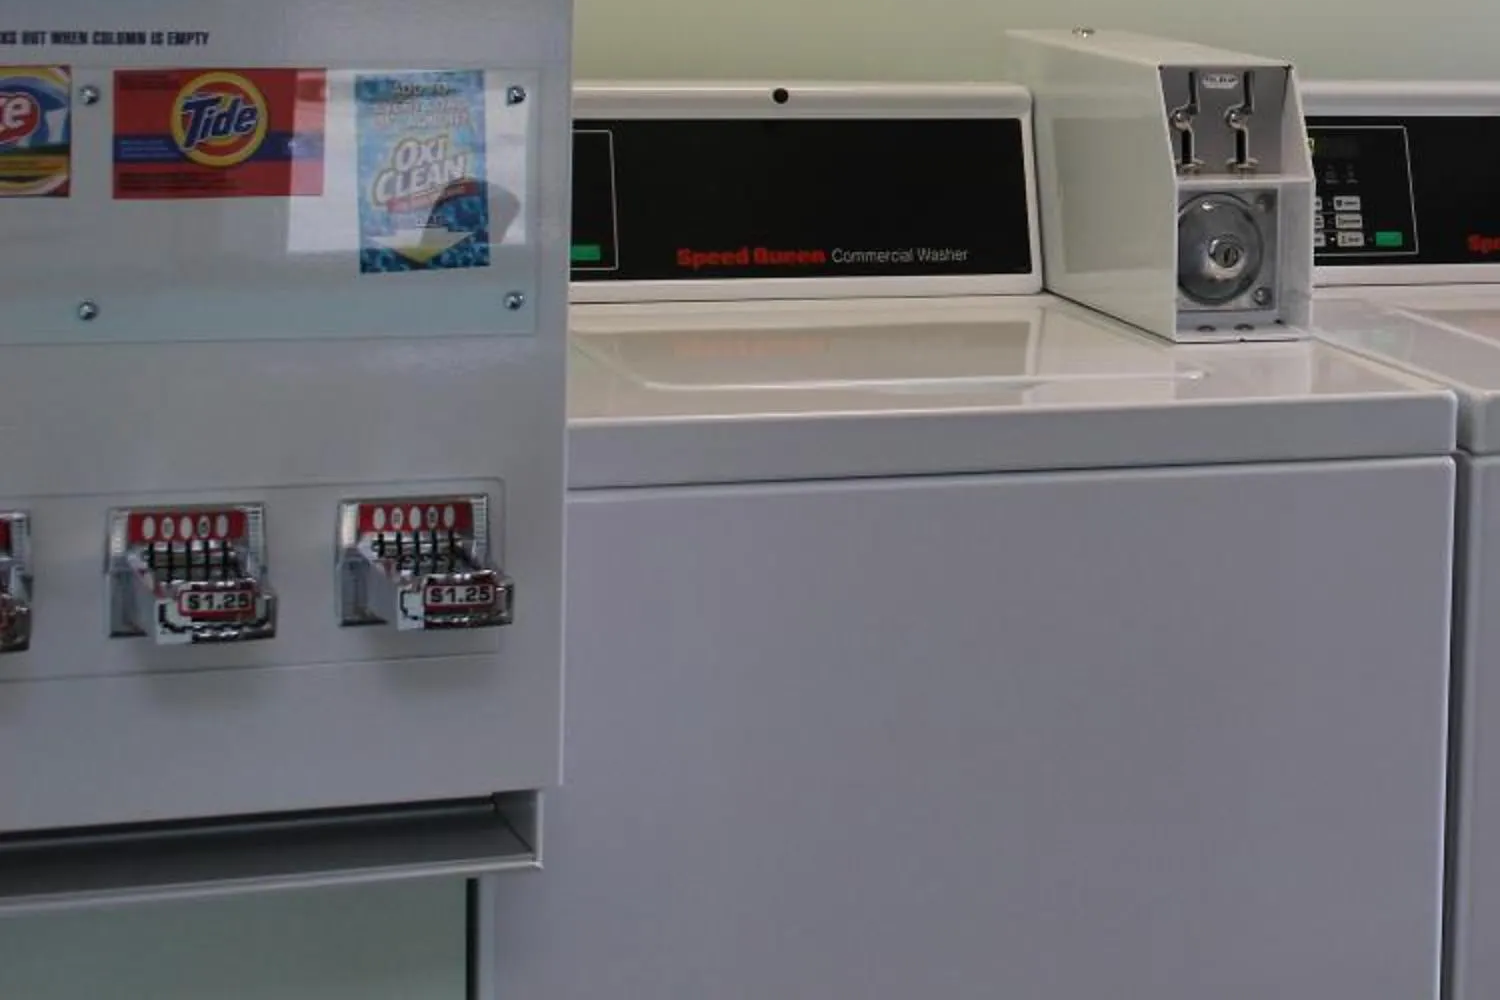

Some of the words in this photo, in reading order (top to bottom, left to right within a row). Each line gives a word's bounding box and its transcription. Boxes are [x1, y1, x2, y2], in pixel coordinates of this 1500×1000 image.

[22, 31, 47, 45] OUT
[51, 31, 88, 44] WHEN
[93, 31, 146, 44] COLUMN
[150, 31, 164, 44] IS
[167, 31, 209, 45] EMPTY
[182, 94, 258, 149] Tide
[374, 153, 465, 206] CLEAN
[677, 248, 748, 269] Speed
[753, 247, 826, 264] Queen
[831, 247, 913, 263] Commercial
[917, 247, 969, 262] Washer
[187, 593, 250, 611] $1.25
[431, 587, 490, 604] $1.25
